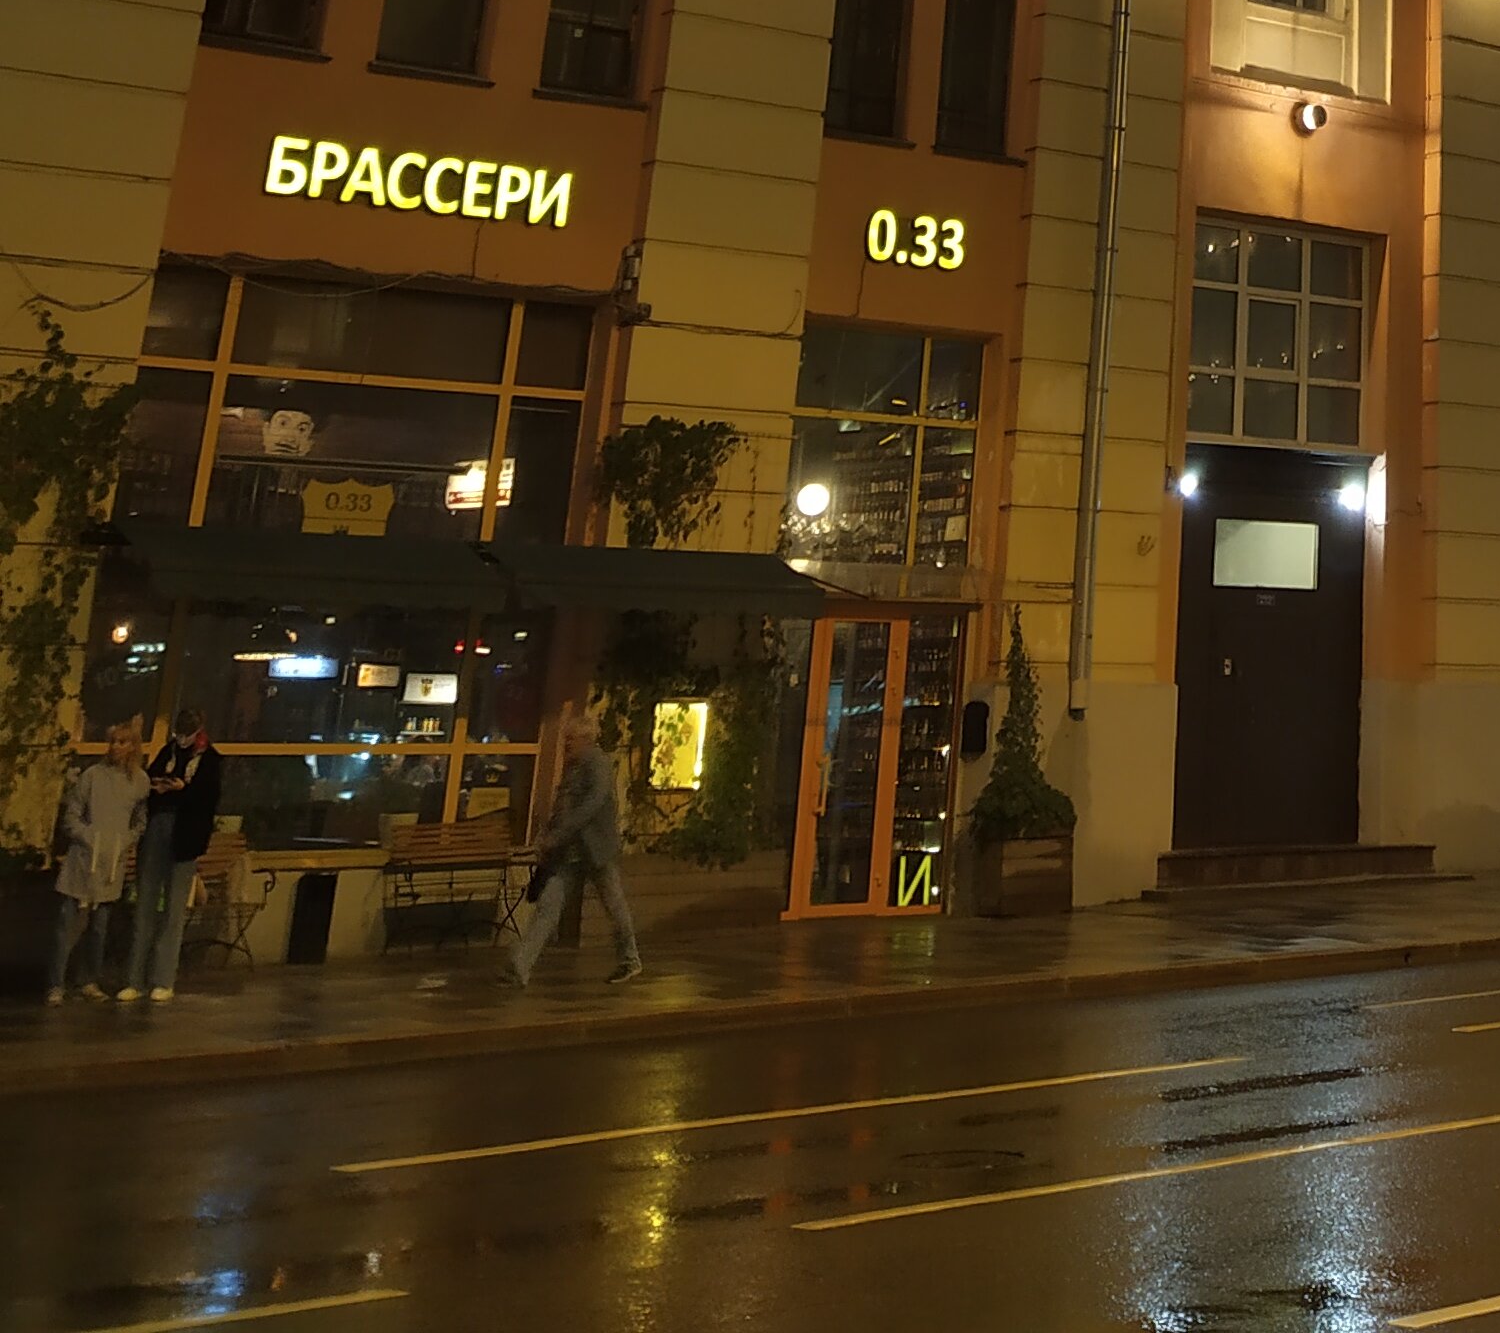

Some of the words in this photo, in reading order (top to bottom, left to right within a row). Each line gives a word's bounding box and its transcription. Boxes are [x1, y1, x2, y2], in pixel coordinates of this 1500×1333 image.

[265, 135, 573, 227] БРАССЕРИ
[868, 209, 964, 270] 0.33
[325, 492, 372, 512] 0.33
